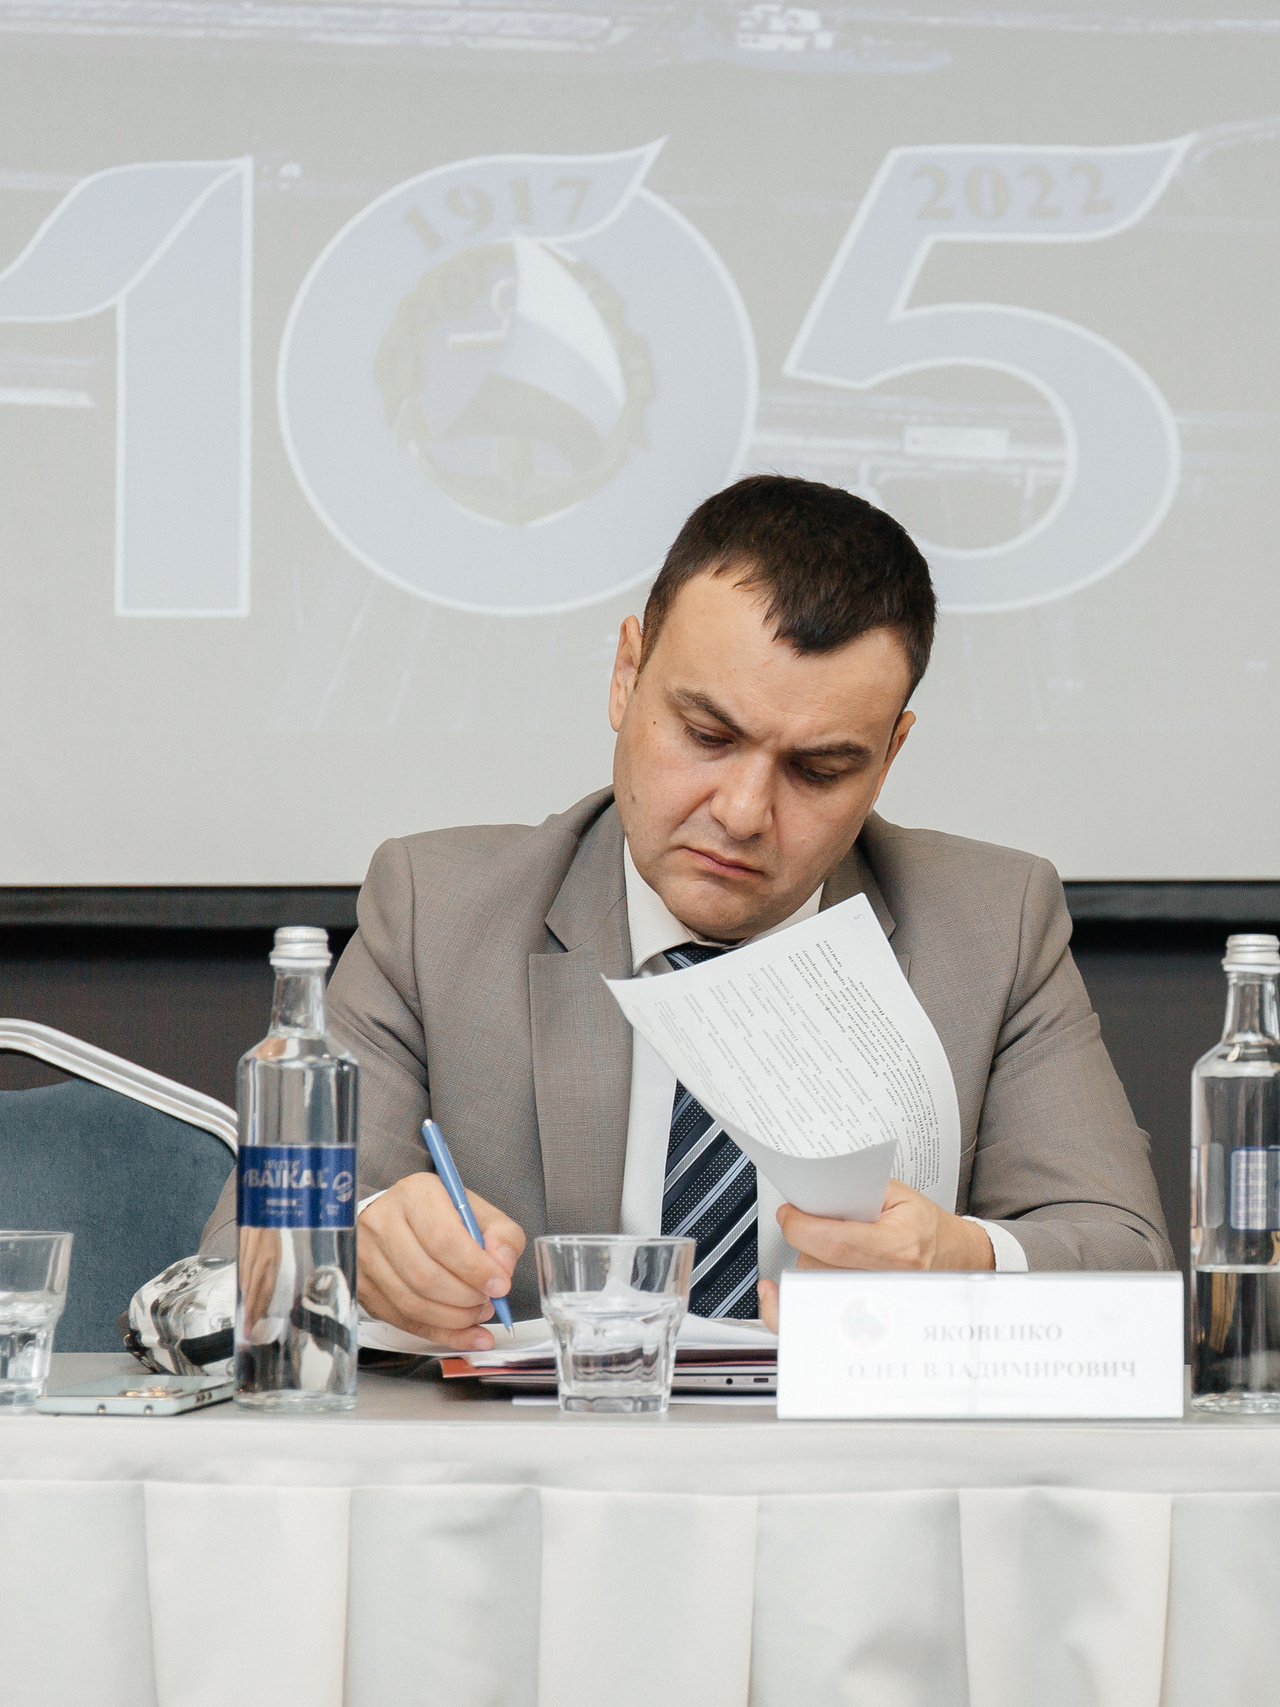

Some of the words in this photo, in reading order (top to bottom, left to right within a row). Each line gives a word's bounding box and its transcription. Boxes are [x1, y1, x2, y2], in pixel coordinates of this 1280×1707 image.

[910, 160, 1115, 221] 2022
[404, 177, 593, 250] 1917
[922, 1323, 1063, 1342] ЯКОВЕНКО
[847, 1361, 909, 1380] ОЛЕГ
[923, 1360, 1137, 1381] ВЛАДИМИРОВИЧ
